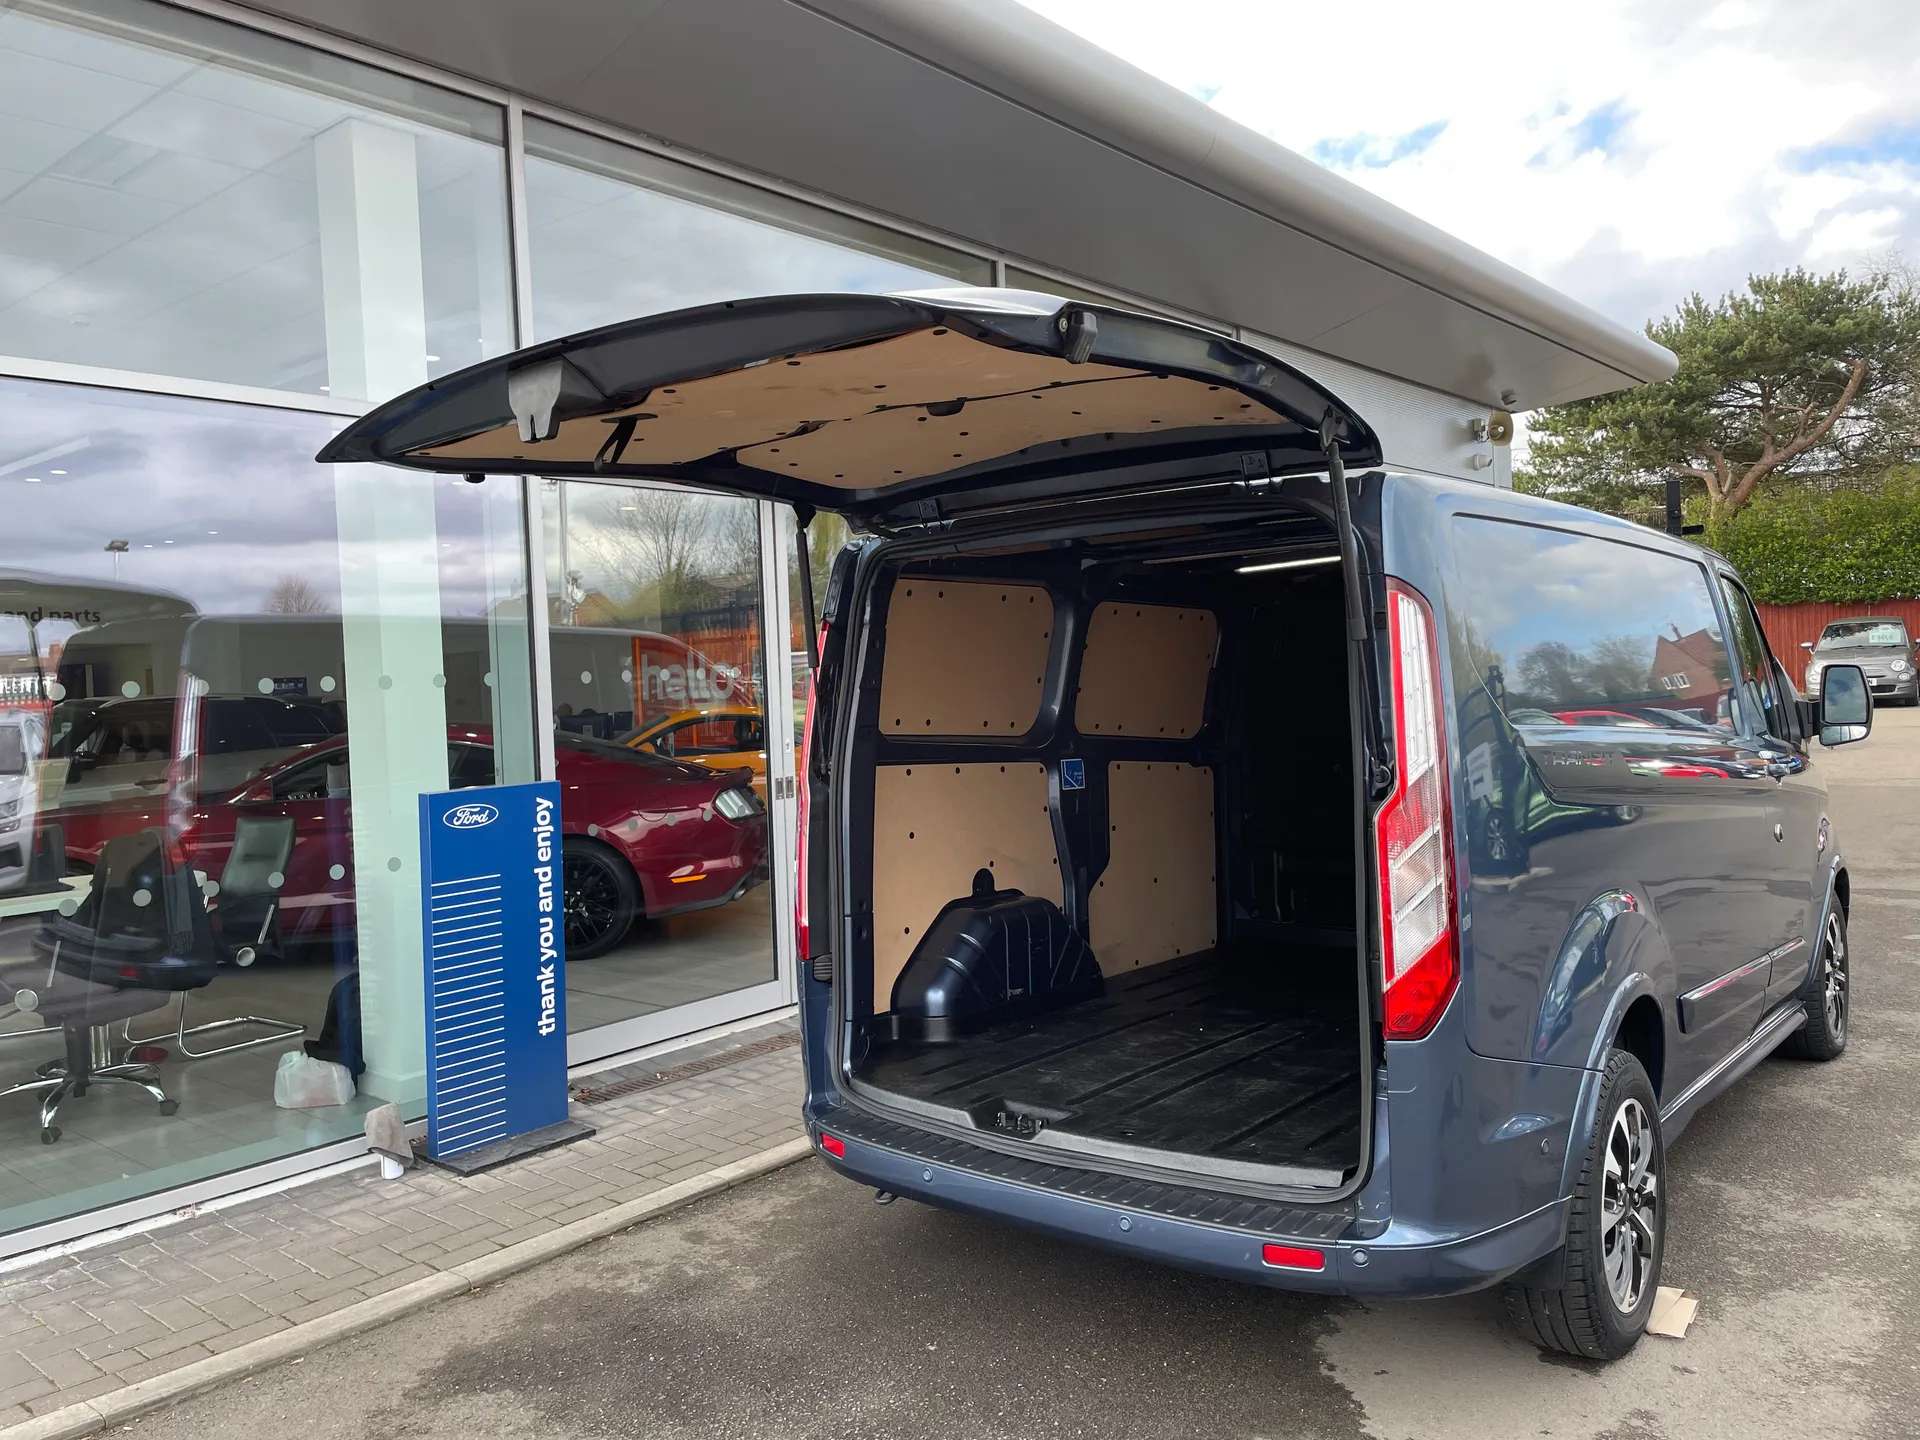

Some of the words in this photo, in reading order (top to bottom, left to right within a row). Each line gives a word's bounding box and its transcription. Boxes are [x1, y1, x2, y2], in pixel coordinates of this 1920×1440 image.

[4, 607, 43, 622] nd
[1543, 751, 1617, 766] TRANSIT
[452, 806, 490, 826] Ford
[532, 797, 555, 862] enjoy
[533, 866, 554, 912] and
[537, 918, 558, 958] you
[537, 964, 556, 1036] thank
